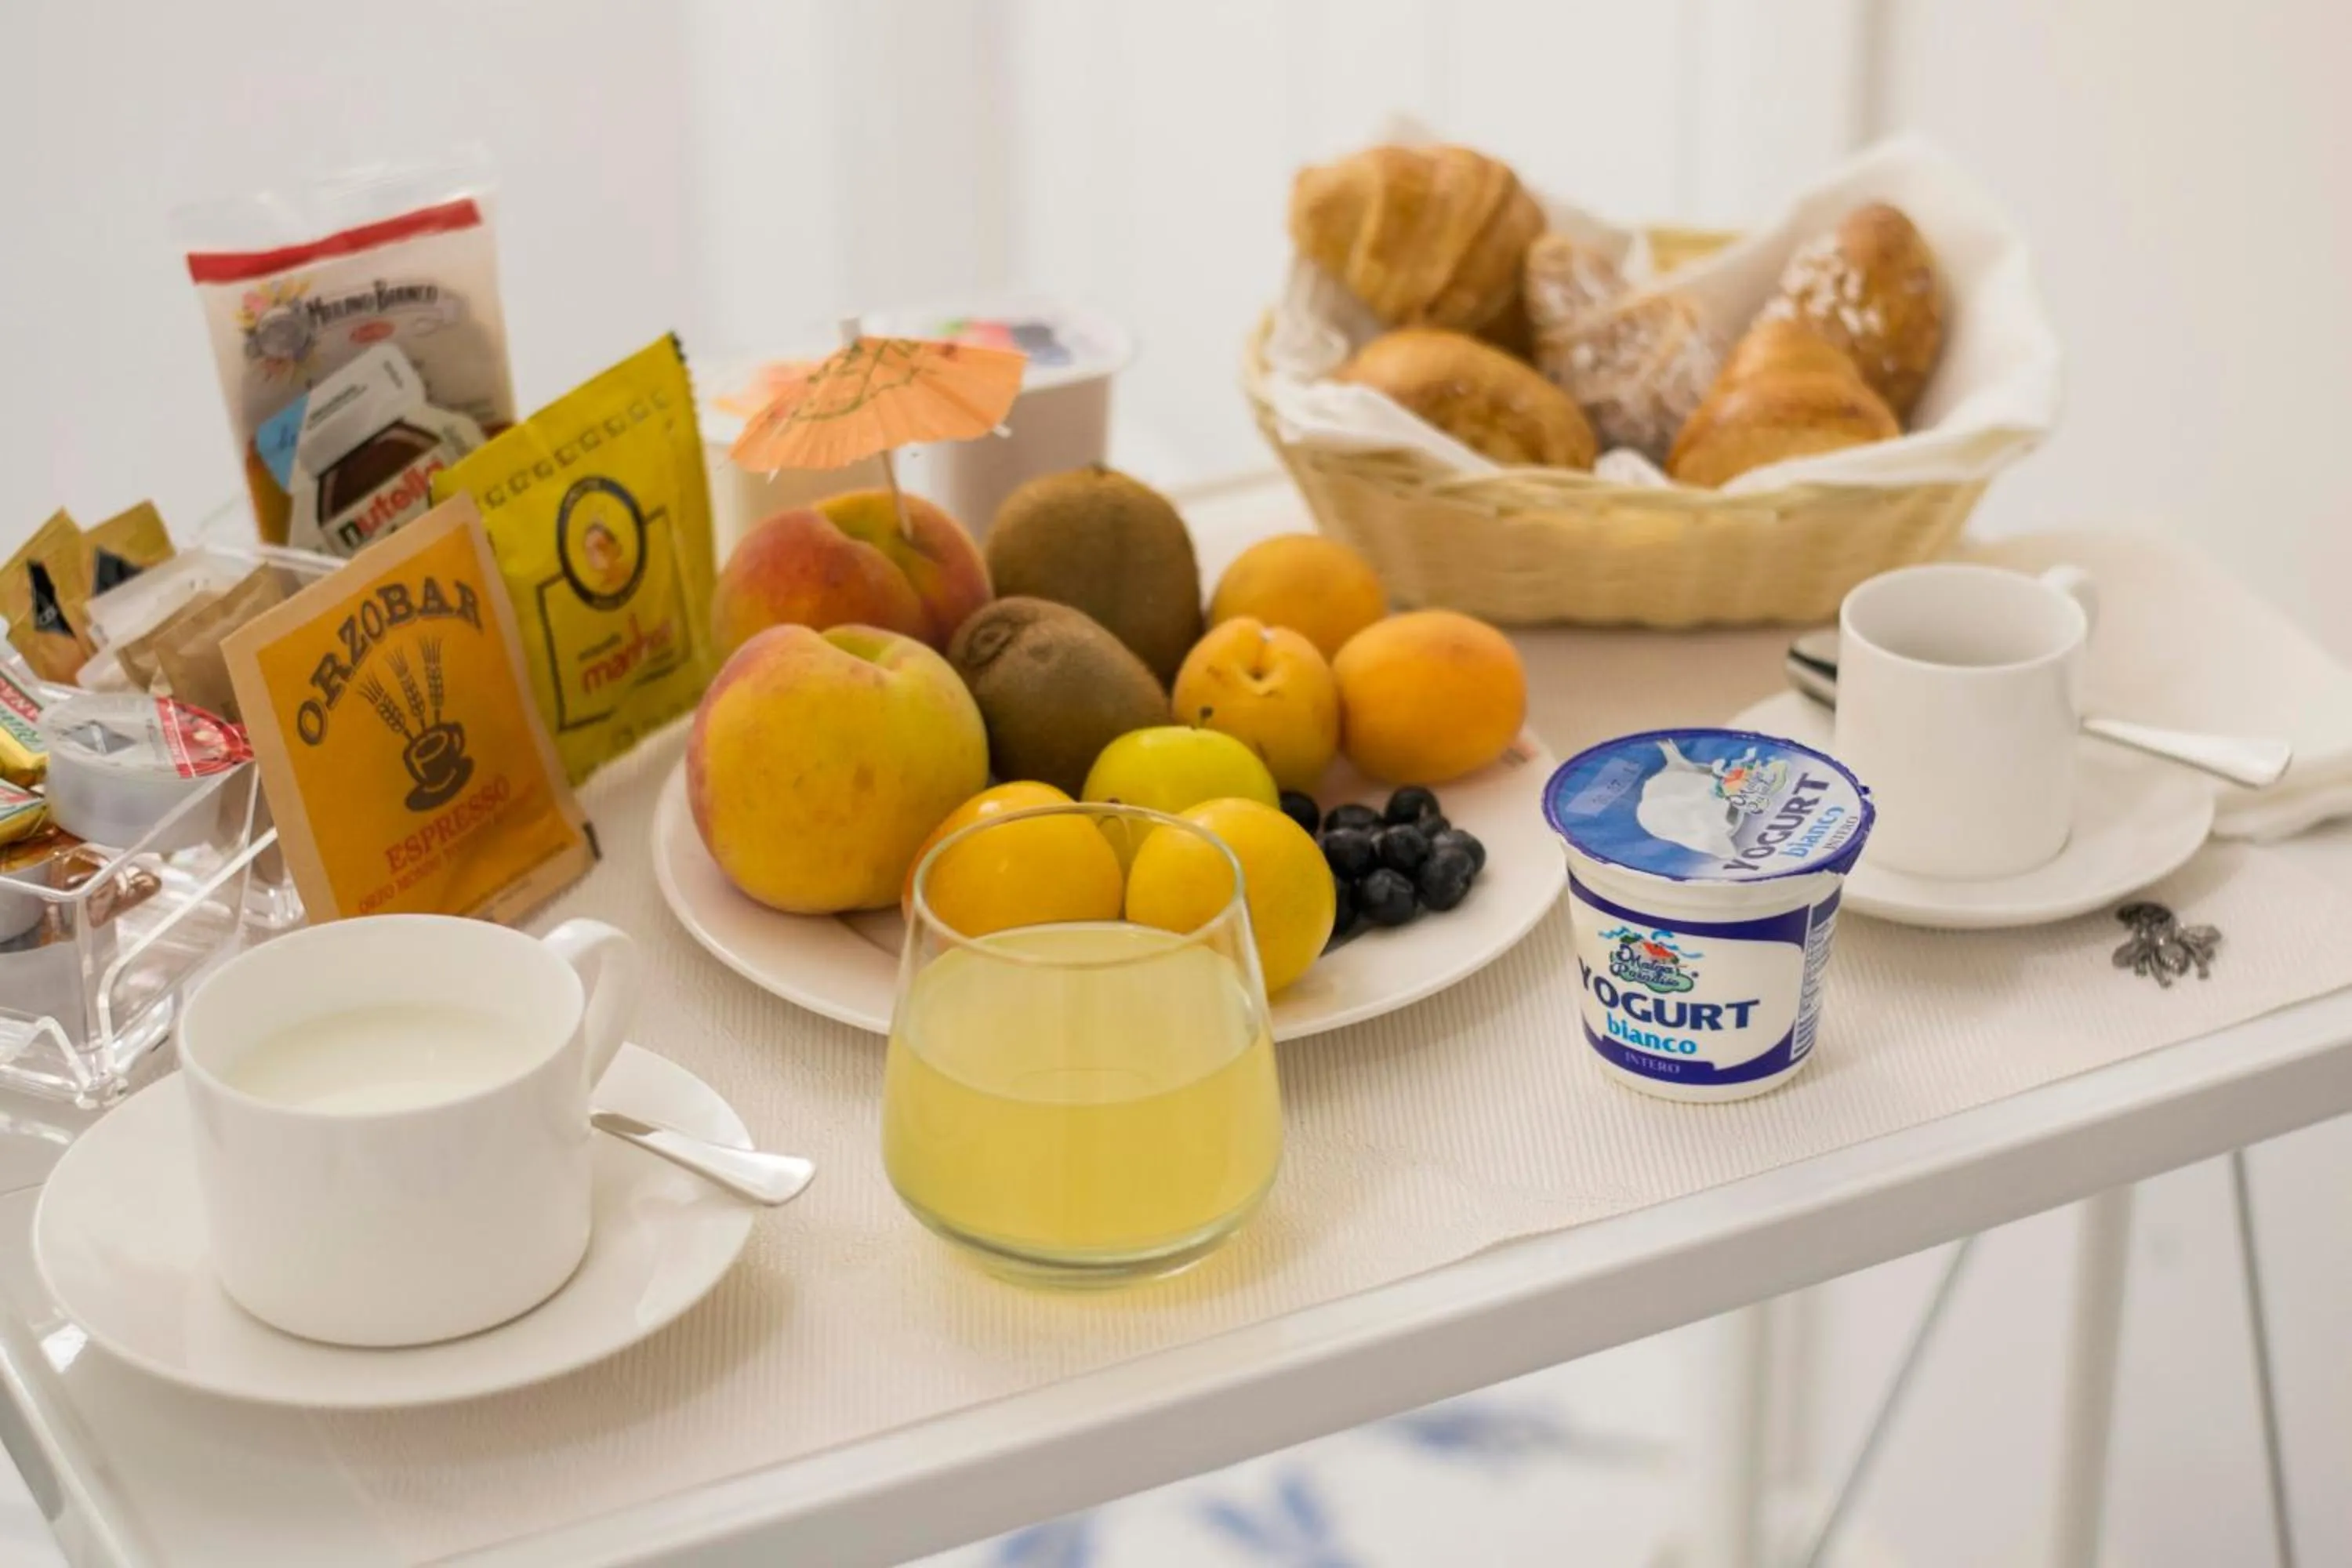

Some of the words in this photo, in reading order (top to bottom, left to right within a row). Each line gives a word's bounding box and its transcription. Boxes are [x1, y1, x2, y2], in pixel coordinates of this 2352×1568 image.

[296, 575, 485, 747] ORZOBAR
[384, 772, 510, 875] ESPRESSO
[1722, 771, 1831, 871] YOGURT
[1778, 805, 1846, 858] bianco
[1577, 953, 1761, 1031] YOGURT
[1606, 1011, 1697, 1055] bianco
[1624, 1051, 1681, 1075] INTERO
